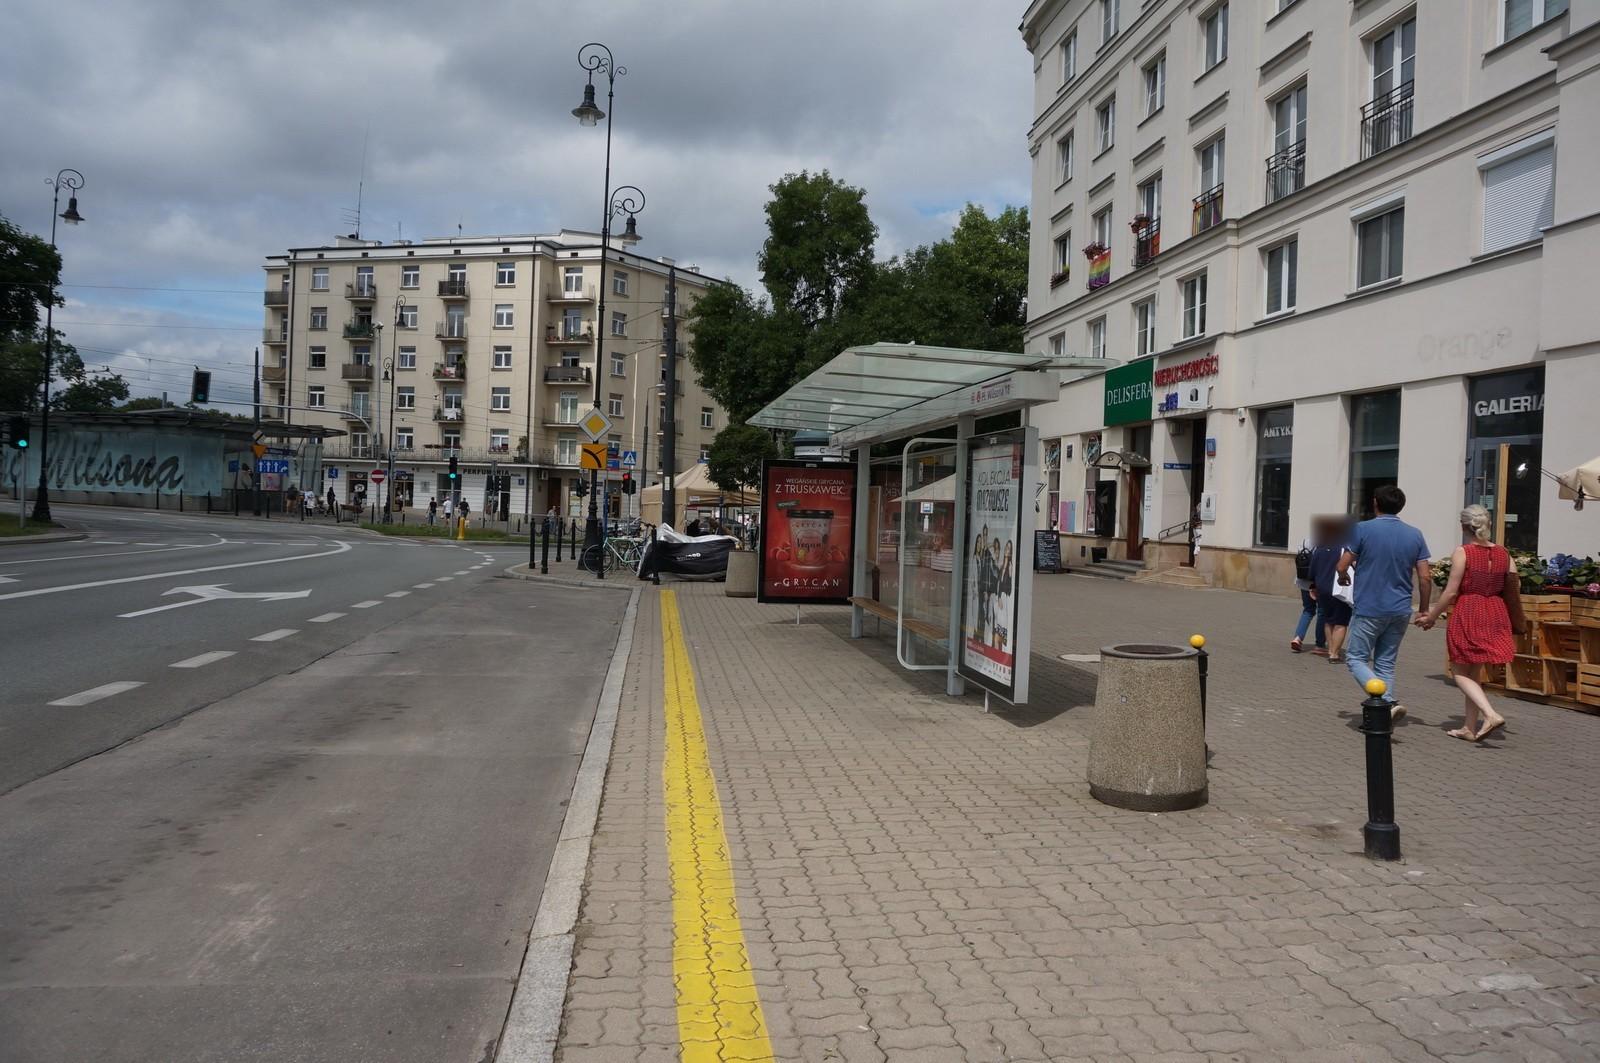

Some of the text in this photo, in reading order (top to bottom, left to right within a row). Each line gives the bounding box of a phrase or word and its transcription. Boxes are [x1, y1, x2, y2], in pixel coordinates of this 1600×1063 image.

[1107, 381, 1152, 406] DELISFERA
[775, 484, 782, 493] Z
[783, 578, 840, 587] GRYCAN
